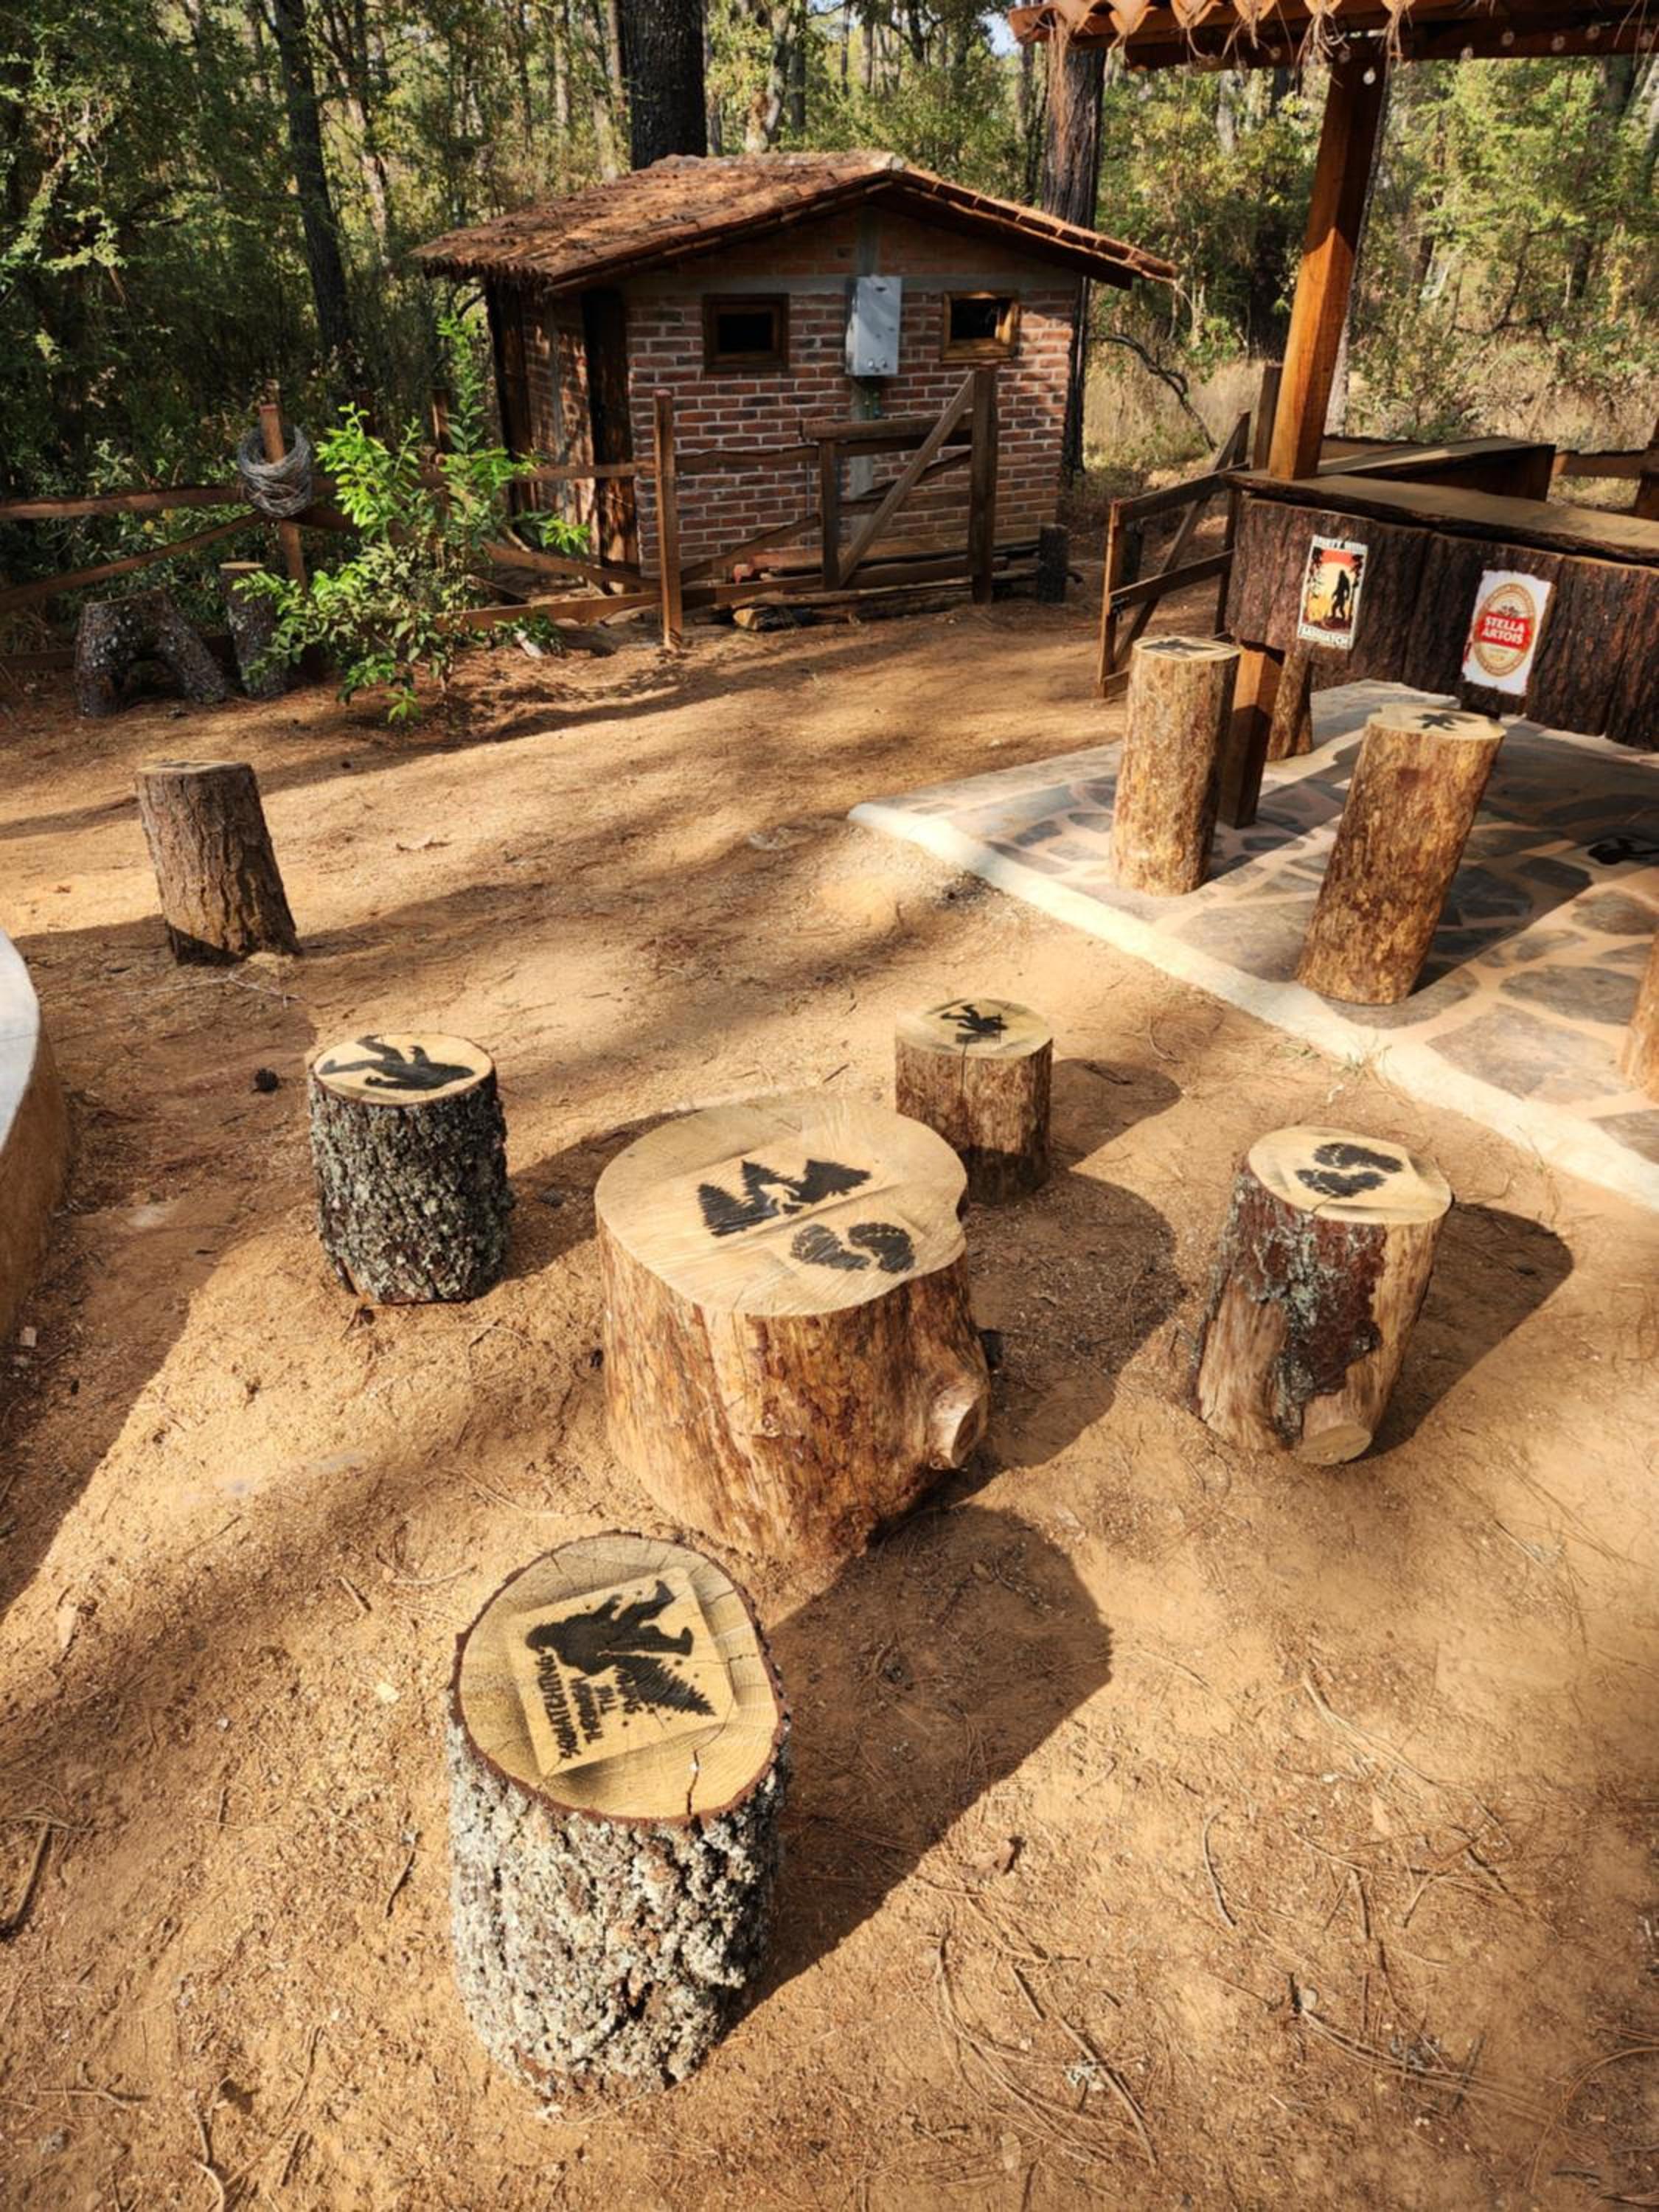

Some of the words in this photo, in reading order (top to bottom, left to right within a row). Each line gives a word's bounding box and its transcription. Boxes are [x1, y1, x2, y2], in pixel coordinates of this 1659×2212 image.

[1481, 627, 1523, 645] ARTOIS
[1484, 615, 1526, 633] STELLA
[570, 1676, 604, 1745] THROUGH
[594, 1684, 618, 1715] THE
